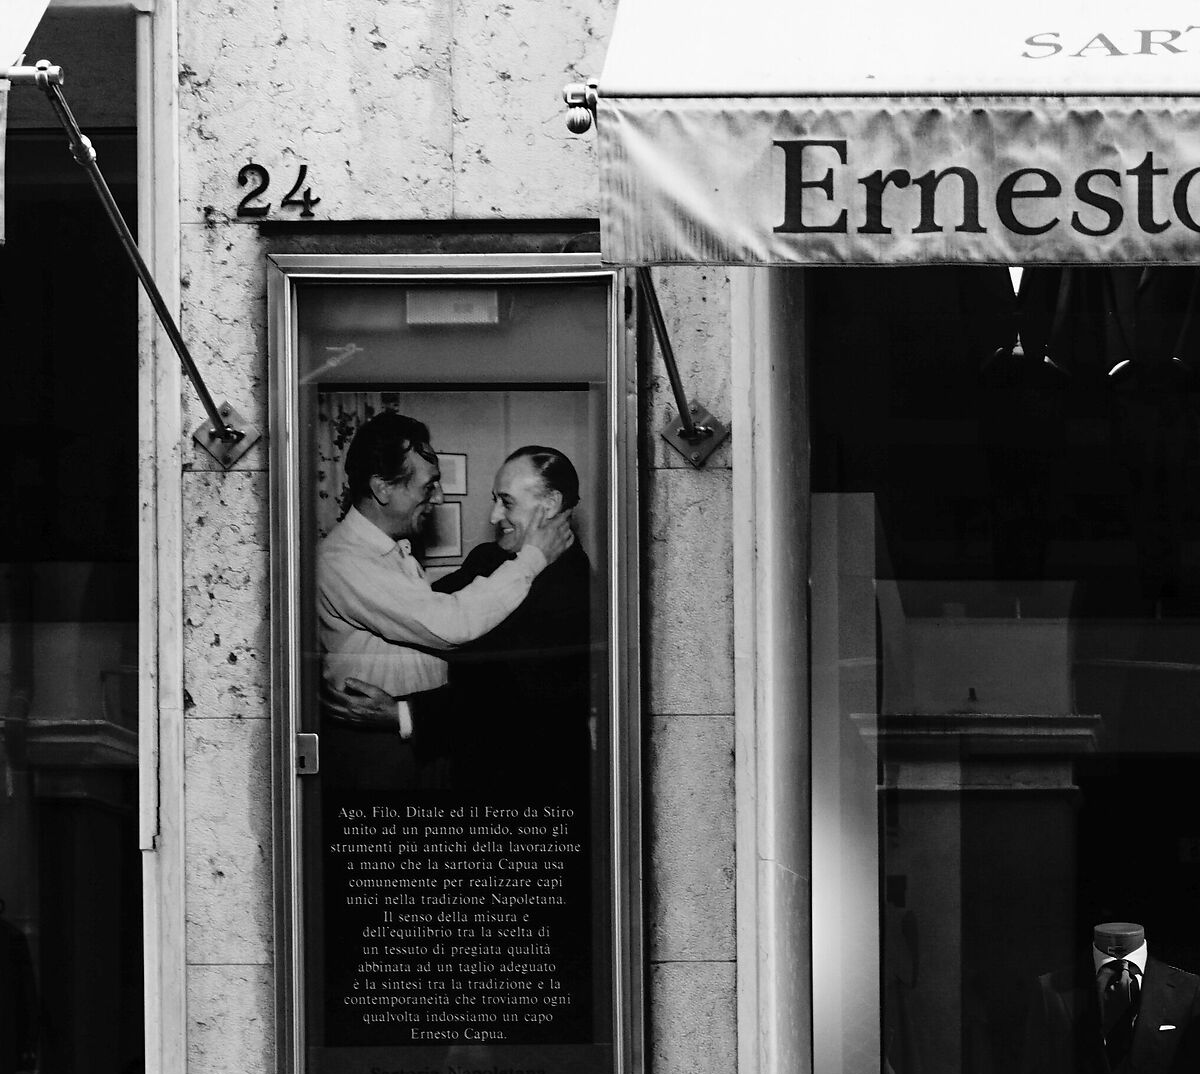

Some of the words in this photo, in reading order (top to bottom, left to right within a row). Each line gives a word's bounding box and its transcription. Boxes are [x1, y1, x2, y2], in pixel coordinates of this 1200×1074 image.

[236, 163, 322, 218] 24
[406, 806, 445, 818] Ditale
[449, 806, 464, 818] ed
[470, 806, 479, 818] il
[484, 806, 519, 818] Ferro
[523, 806, 538, 818] da
[543, 806, 574, 818] Stiro
[343, 823, 377, 835] unito
[381, 824, 397, 835] ad
[402, 826, 419, 835] un
[424, 826, 464, 838] panno
[517, 826, 547, 835] sono
[551, 823, 568, 838] gli
[330, 840, 392, 853] strumenti
[423, 840, 467, 853] antichi
[472, 841, 503, 853] della
[509, 840, 581, 853] lavorazione
[360, 861, 396, 870] mano
[400, 858, 422, 870] che
[427, 858, 439, 870] la
[444, 858, 493, 870] sartoria
[498, 858, 538, 872] Capua
[543, 861, 564, 870] usa
[348, 878, 438, 888] comunemente
[443, 878, 464, 890] per
[469, 875, 532, 888] realizzare
[536, 875, 563, 890] capi
[346, 893, 379, 905] unici
[384, 893, 416, 905] nella
[421, 893, 486, 905] tradizione
[383, 910, 393, 923] Il
[398, 913, 433, 923] senso
[437, 911, 468, 923] della
[474, 910, 518, 923] misura
[457, 928, 475, 938] tra
[481, 926, 492, 938] la
[497, 926, 533, 938] scelta
[537, 926, 550, 938] di
[362, 946, 379, 955] un
[384, 945, 428, 955] tessuto
[432, 943, 445, 955] di
[450, 943, 502, 958] pregiata
[357, 961, 411, 973] abbinata
[416, 961, 432, 973] ad
[437, 963, 453, 973] un
[458, 960, 495, 975] taglio
[499, 960, 556, 975] adeguato
[365, 978, 377, 990] la
[381, 978, 422, 990] sintesi
[427, 980, 446, 990] tra
[451, 978, 463, 990] la
[467, 977, 533, 990] tradizione
[550, 978, 561, 990] la
[454, 993, 477, 1005] che
[481, 992, 538, 1005] troviamo
[543, 993, 571, 1007] ogni
[362, 1010, 420, 1025] qualvolta
[426, 1010, 497, 1022] indossiamo
[502, 1013, 519, 1022] un
[523, 1013, 554, 1024] capo
[410, 1028, 460, 1040] Ernesto
